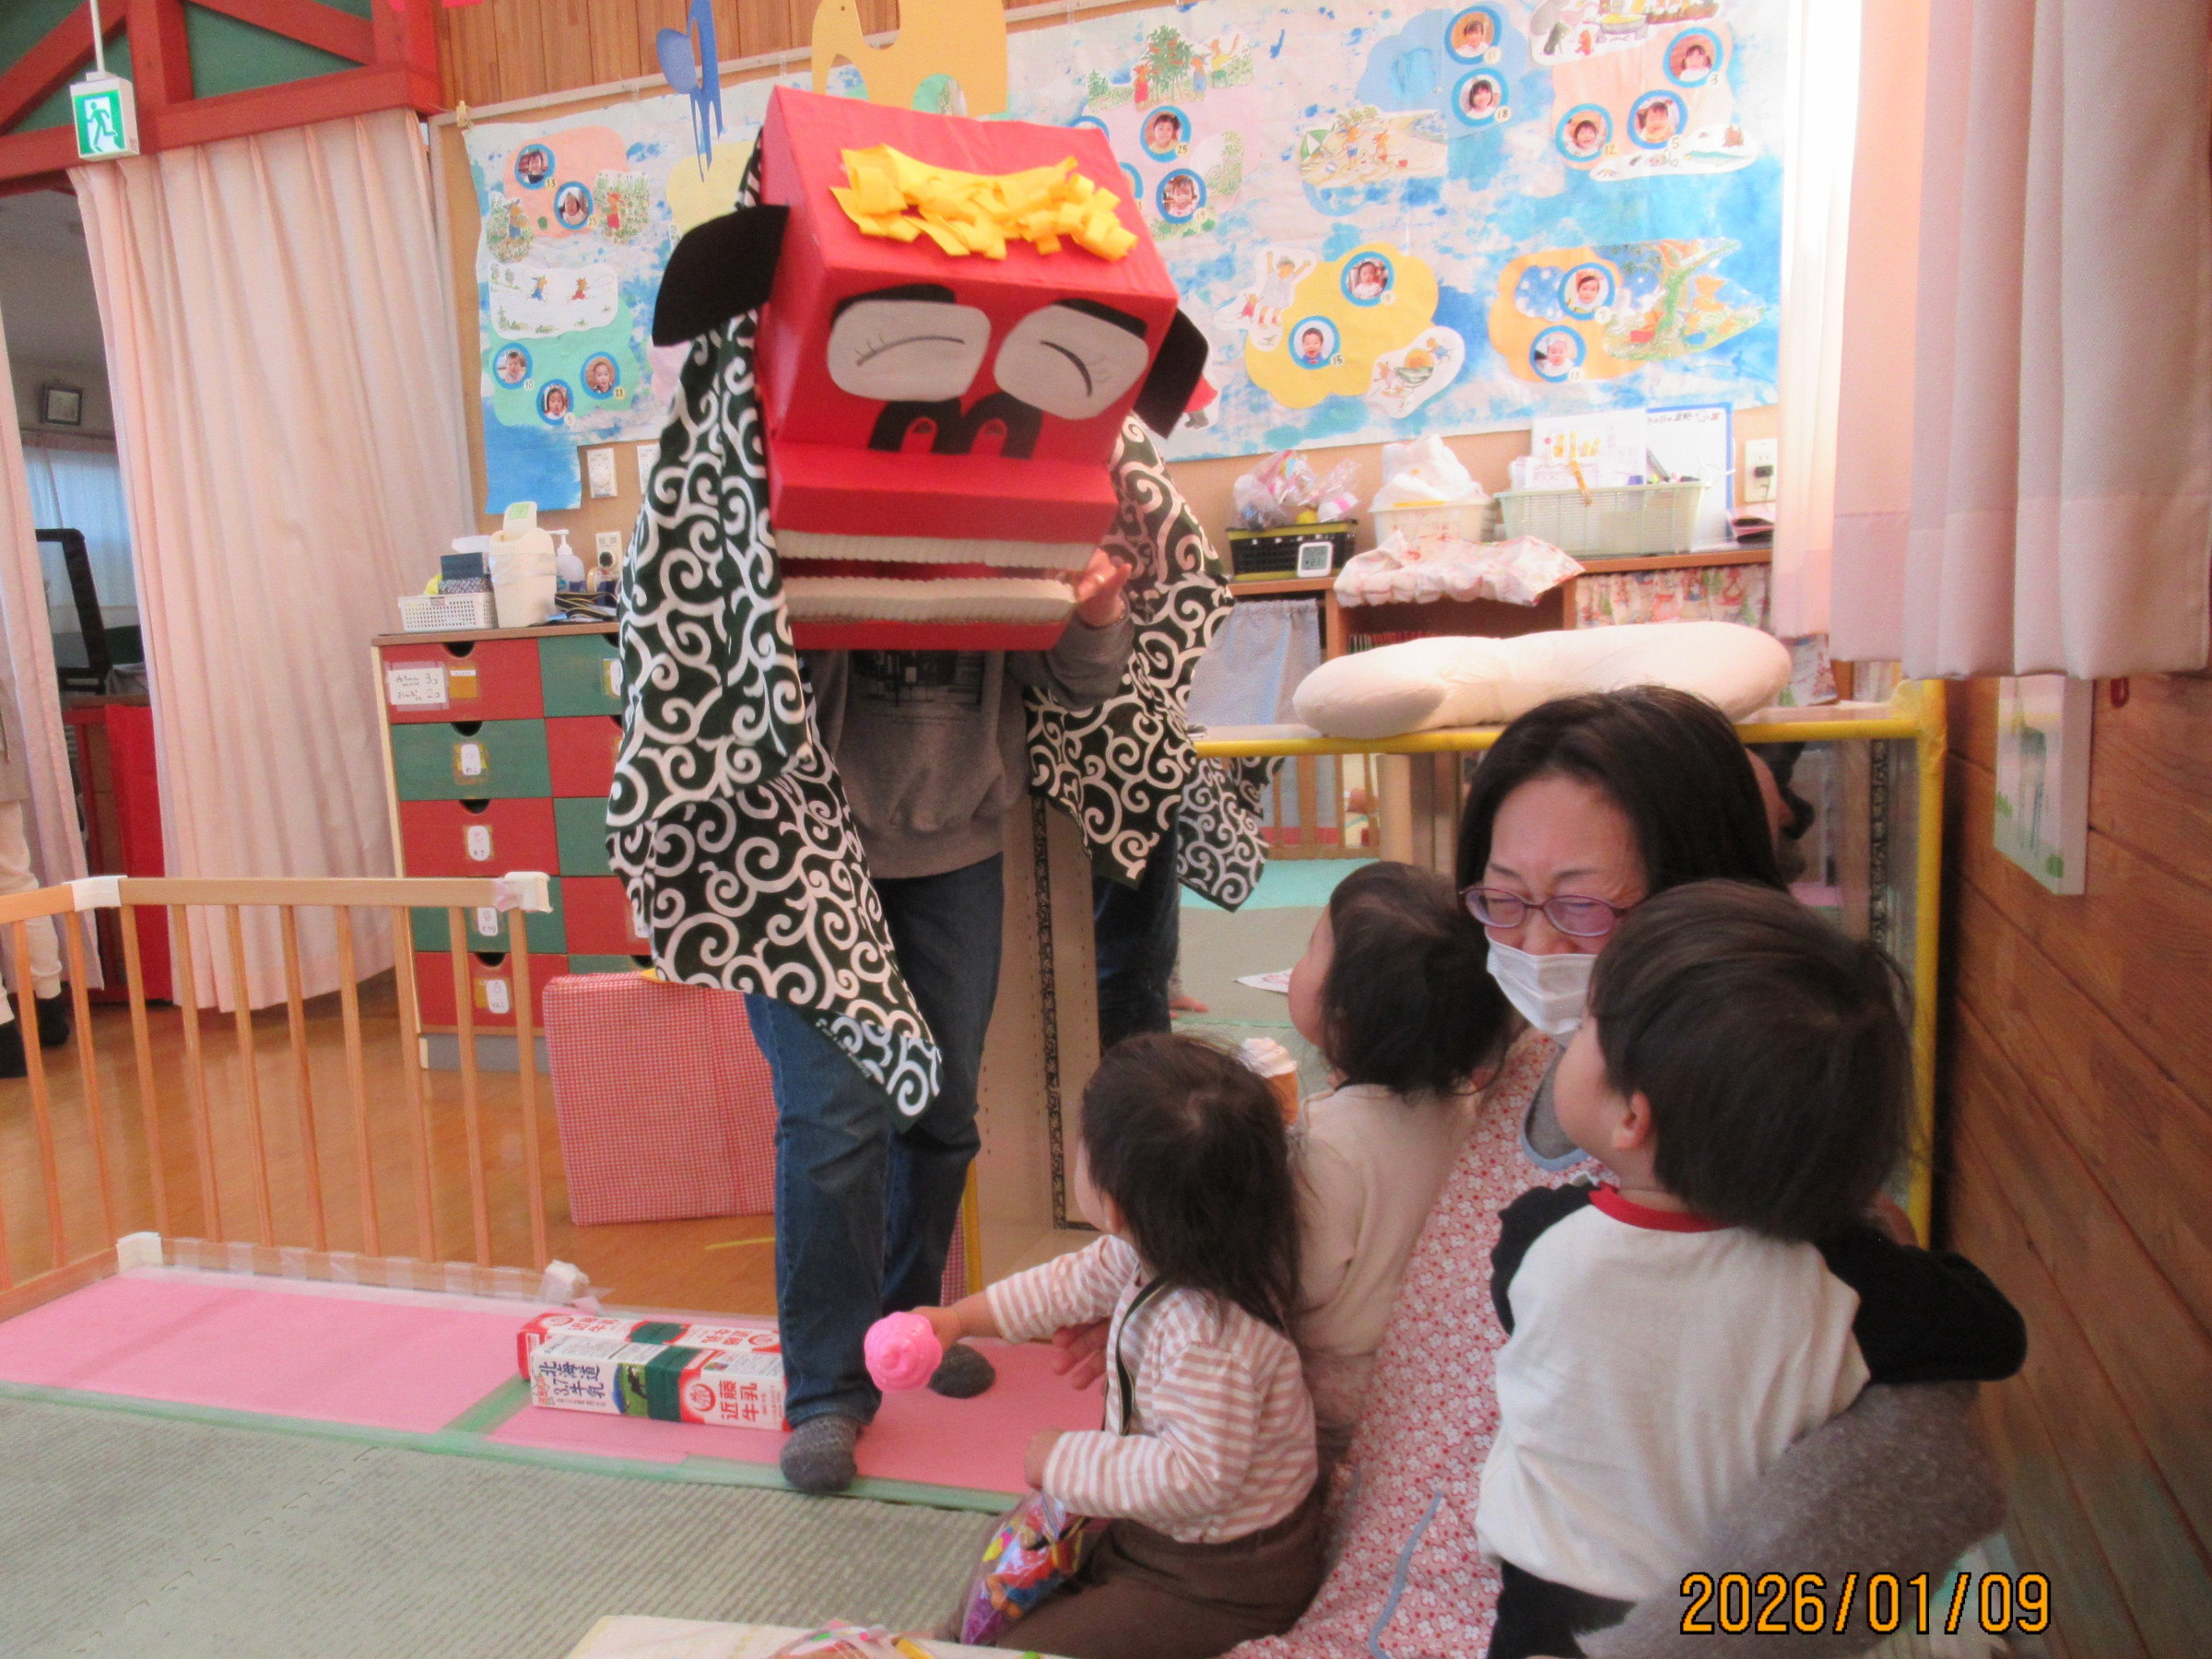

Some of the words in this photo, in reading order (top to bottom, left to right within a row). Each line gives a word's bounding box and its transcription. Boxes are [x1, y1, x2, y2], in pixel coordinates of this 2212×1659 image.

[1711, 74, 1719, 86] 3
[1497, 109, 1508, 119] 18
[1671, 136, 1680, 149] 5
[1177, 145, 1188, 155] 25
[1605, 144, 1617, 156] 12
[1196, 211, 1206, 221] 19
[1333, 354, 1343, 365] 15
[525, 380, 535, 389] 10
[538, 1360, 601, 1382] 北海道
[719, 1380, 739, 1420] 近藤
[740, 1382, 759, 1422] 牛乳
